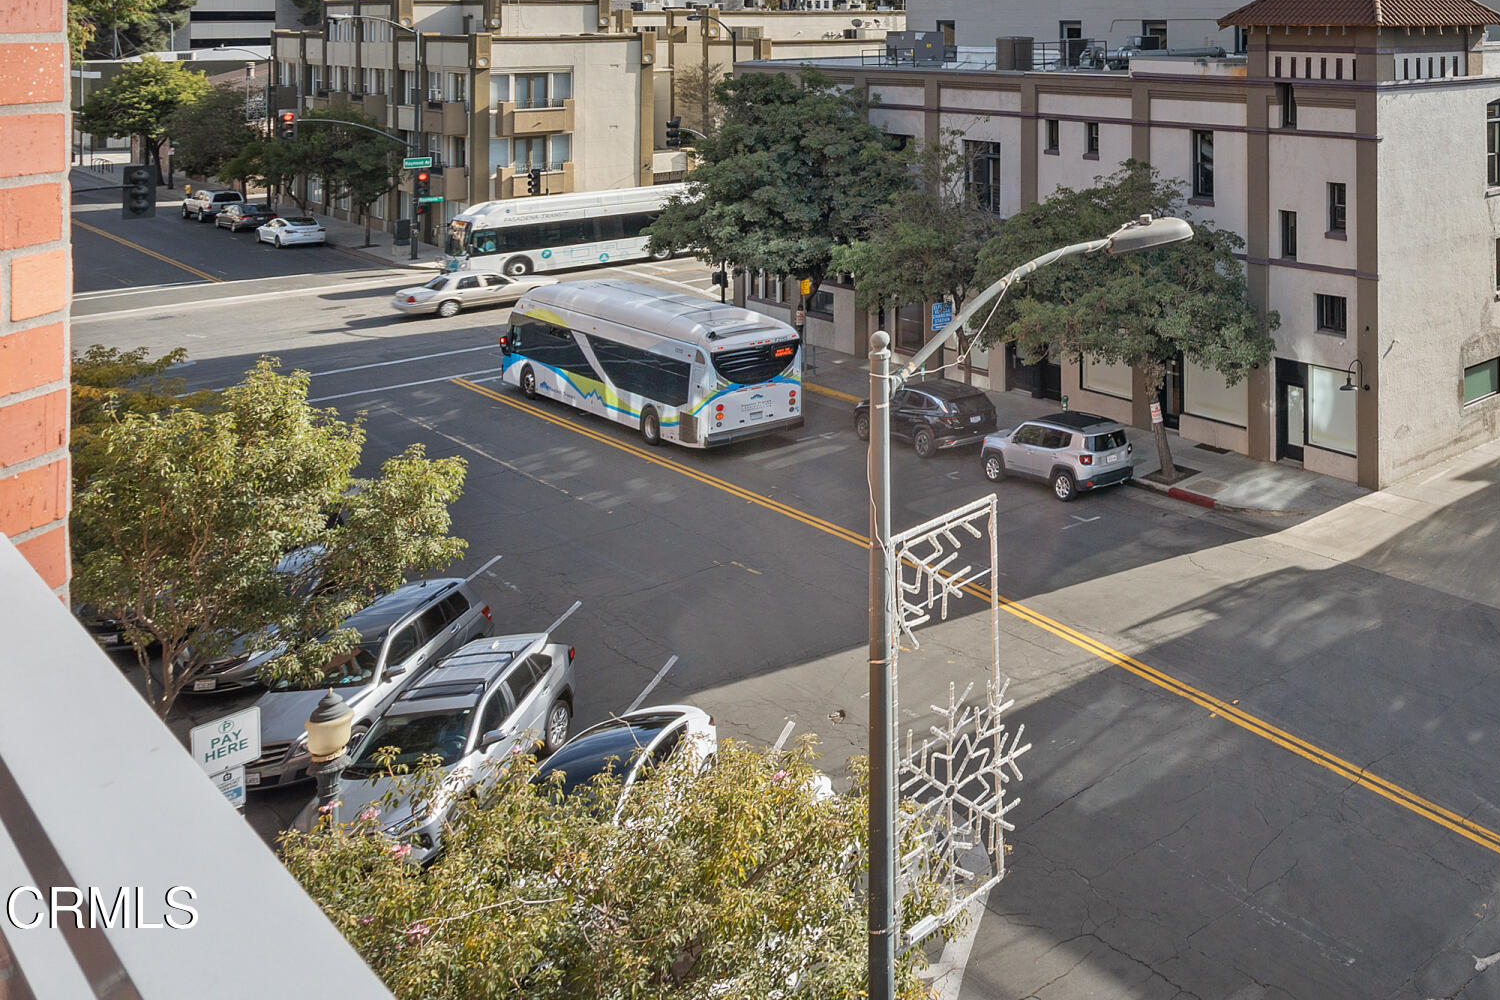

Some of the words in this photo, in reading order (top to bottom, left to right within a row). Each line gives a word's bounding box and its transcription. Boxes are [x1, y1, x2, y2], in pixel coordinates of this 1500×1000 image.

[503, 213, 538, 223] PASADENA
[210, 729, 242, 749] PAY
[204, 738, 248, 763] HERE
